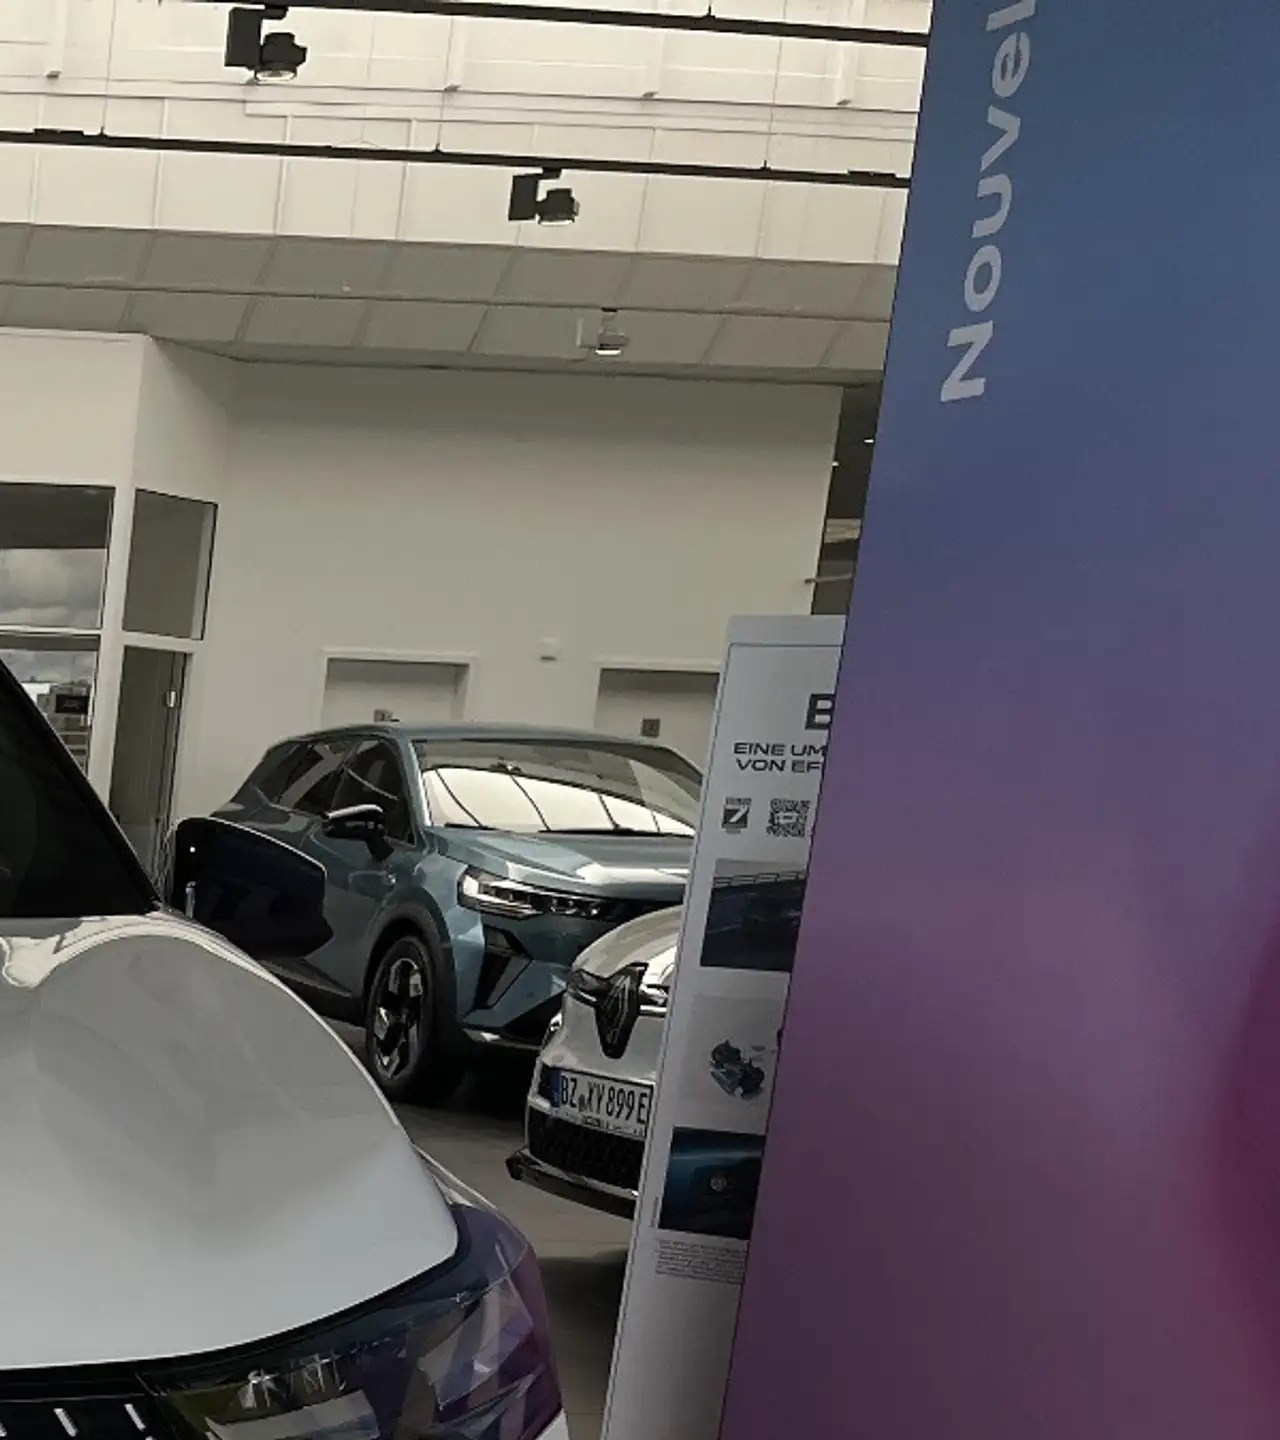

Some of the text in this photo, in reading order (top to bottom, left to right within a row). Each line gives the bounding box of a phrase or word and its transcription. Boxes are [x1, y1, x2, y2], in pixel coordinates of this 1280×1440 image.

[940, 0, 1036, 402] Nouvel
[734, 742, 786, 757] EINE
[736, 758, 787, 773] VON
